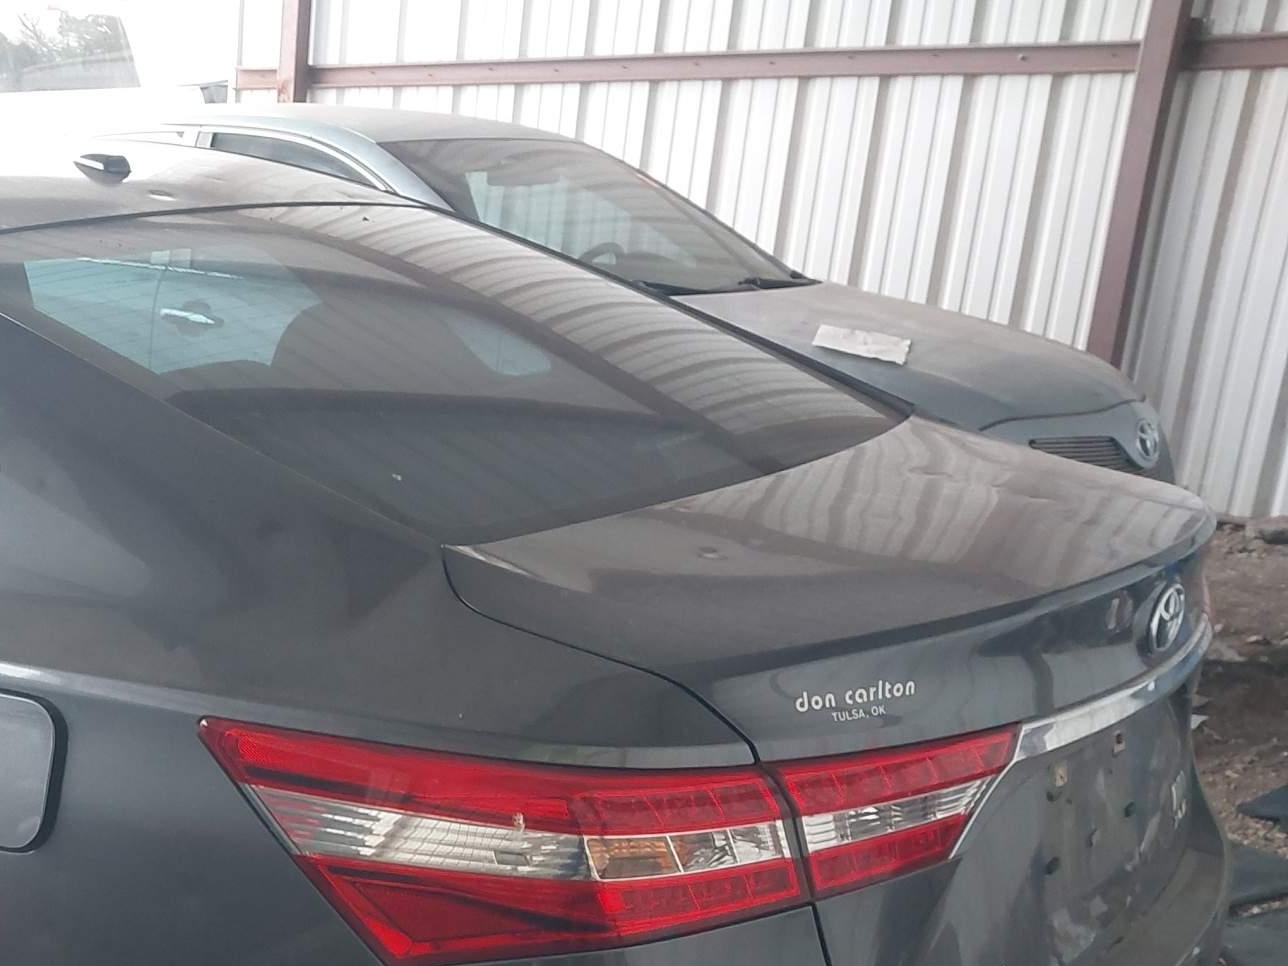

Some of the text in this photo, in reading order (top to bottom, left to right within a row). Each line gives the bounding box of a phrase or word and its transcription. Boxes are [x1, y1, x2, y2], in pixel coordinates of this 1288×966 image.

[795, 680, 915, 712] don carlton
[832, 705, 886, 722] TULSA, OK
